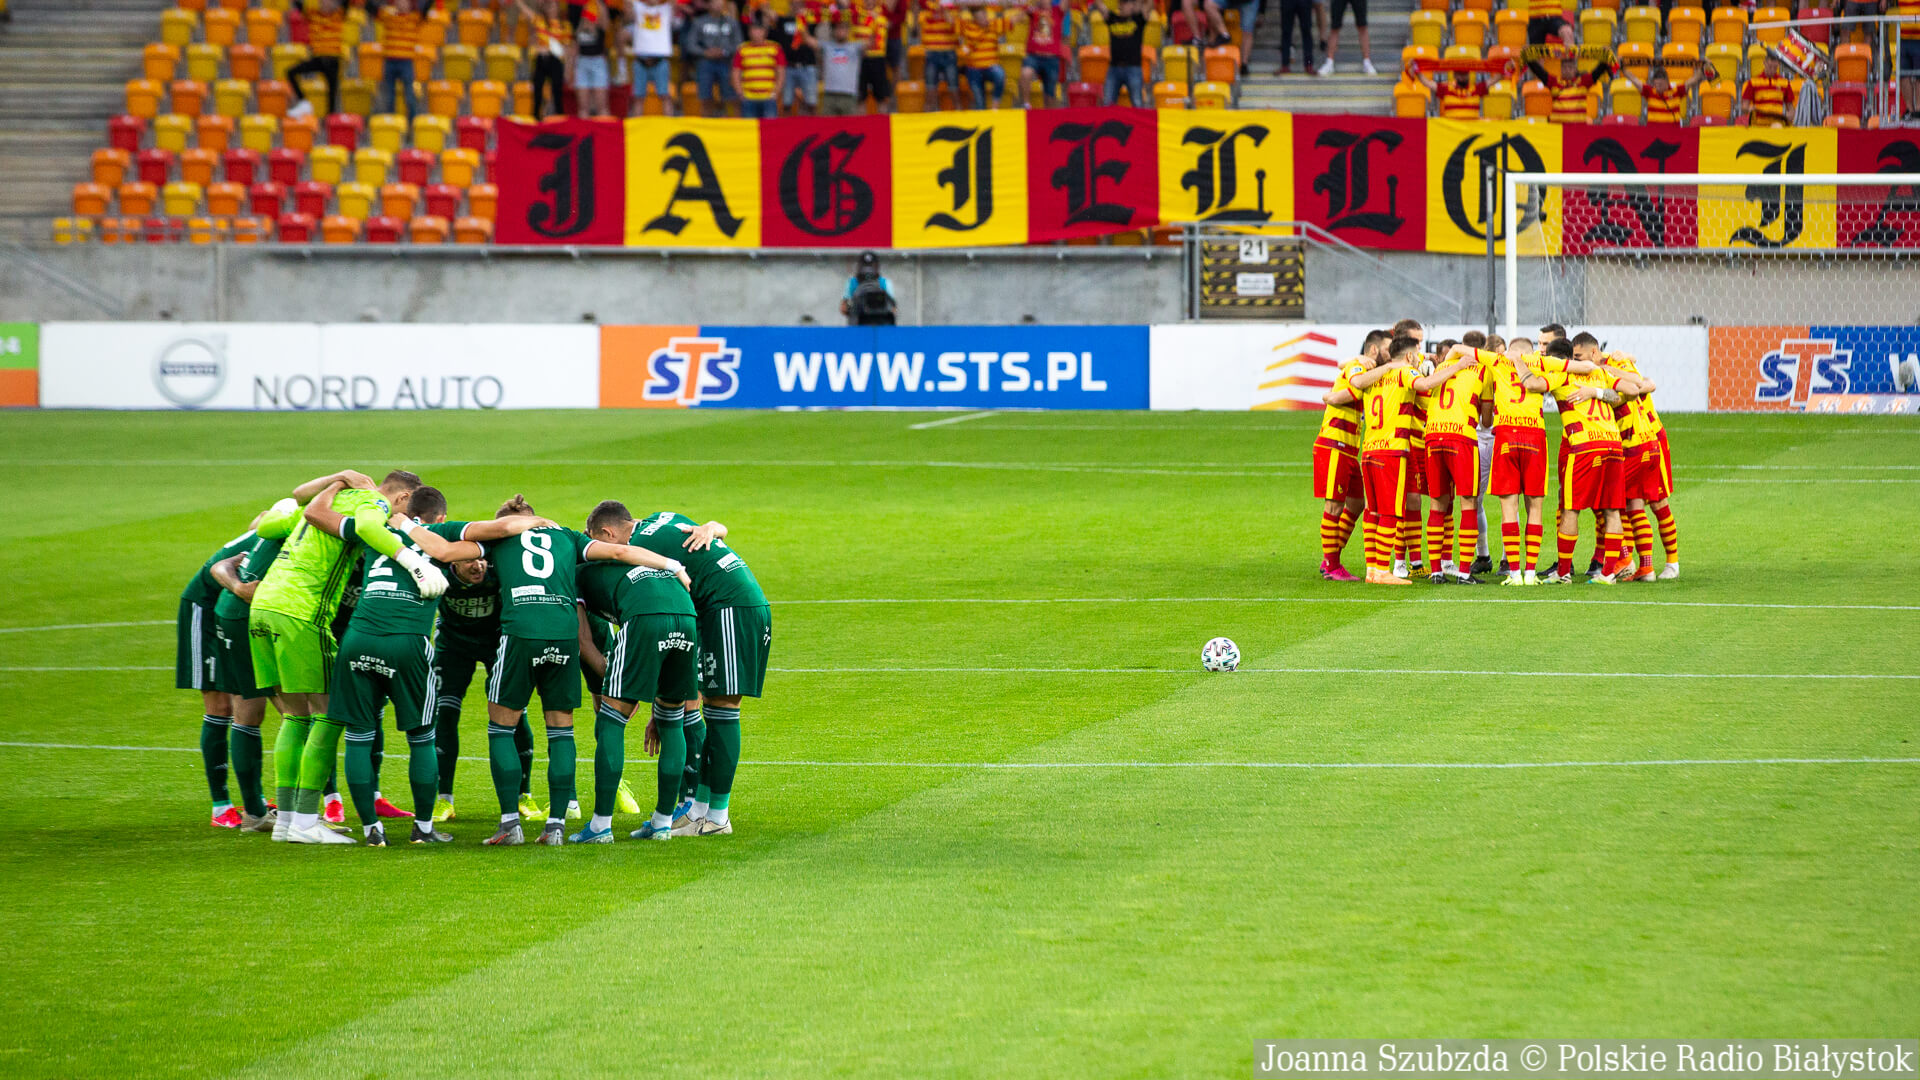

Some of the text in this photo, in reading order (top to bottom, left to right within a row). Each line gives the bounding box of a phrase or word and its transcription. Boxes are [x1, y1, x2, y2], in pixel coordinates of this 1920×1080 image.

[1243, 240, 1263, 256] 21
[642, 337, 741, 405] STS
[773, 351, 1107, 392] WWW.STS.PL
[1510, 372, 1526, 404] 5
[1754, 338, 1853, 407] STS
[253, 374, 504, 410] NORD AUTO
[1439, 376, 1456, 410] 6
[1371, 394, 1384, 430] 9
[521, 530, 554, 579] 8
[359, 655, 386, 665] GRUPA
